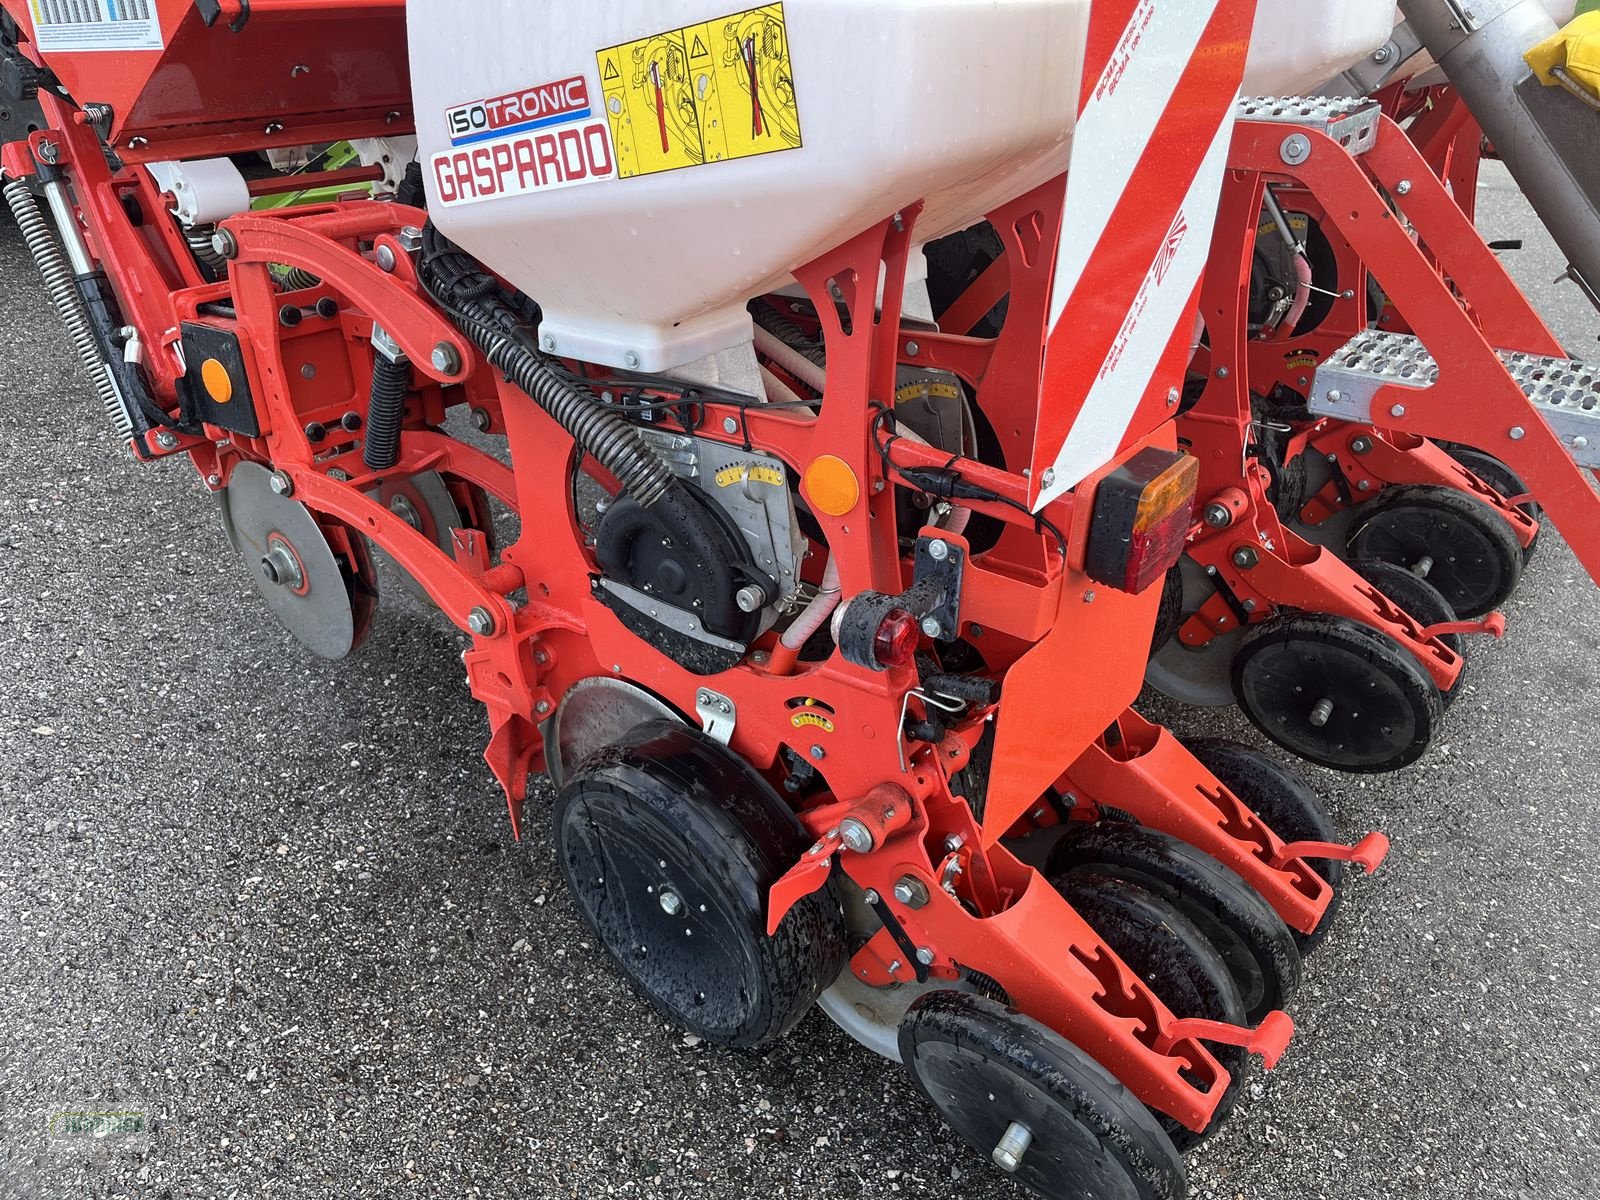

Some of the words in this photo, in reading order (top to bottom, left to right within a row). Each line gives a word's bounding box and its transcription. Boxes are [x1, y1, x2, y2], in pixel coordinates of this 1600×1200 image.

[1096, 58, 1117, 101] BICMA
[1109, 53, 1130, 96] BICMA
[1131, 32, 1141, 51] DIN
[448, 80, 586, 134] ISOTRONIC
[434, 123, 613, 202] GASPARDO
[1100, 344, 1118, 380] BICMA
[1110, 337, 1128, 372] BICMA
[1129, 319, 1137, 334] DIN
